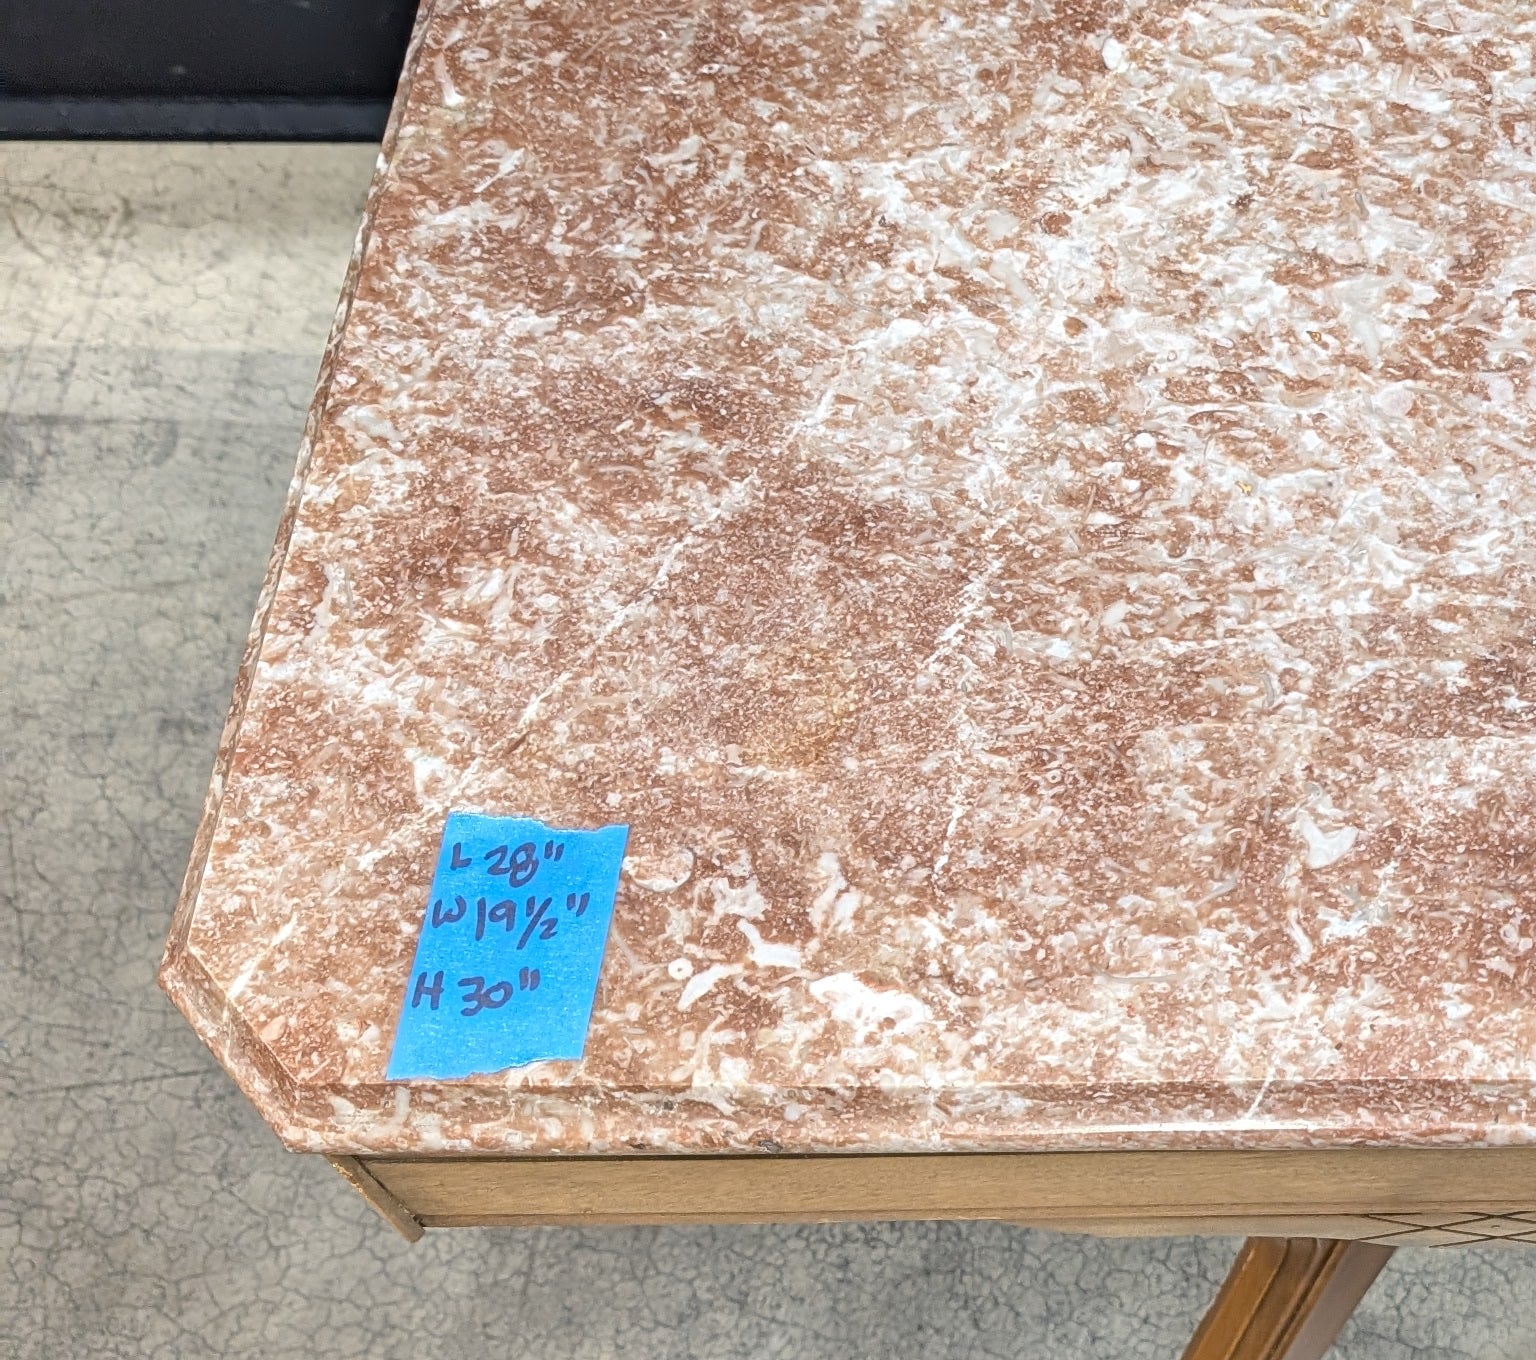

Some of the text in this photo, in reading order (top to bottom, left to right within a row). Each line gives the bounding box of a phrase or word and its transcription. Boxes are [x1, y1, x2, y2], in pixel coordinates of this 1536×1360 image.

[451, 840, 564, 887] L 28"
[432, 895, 467, 928] W
[411, 966, 540, 1016] H 30"
